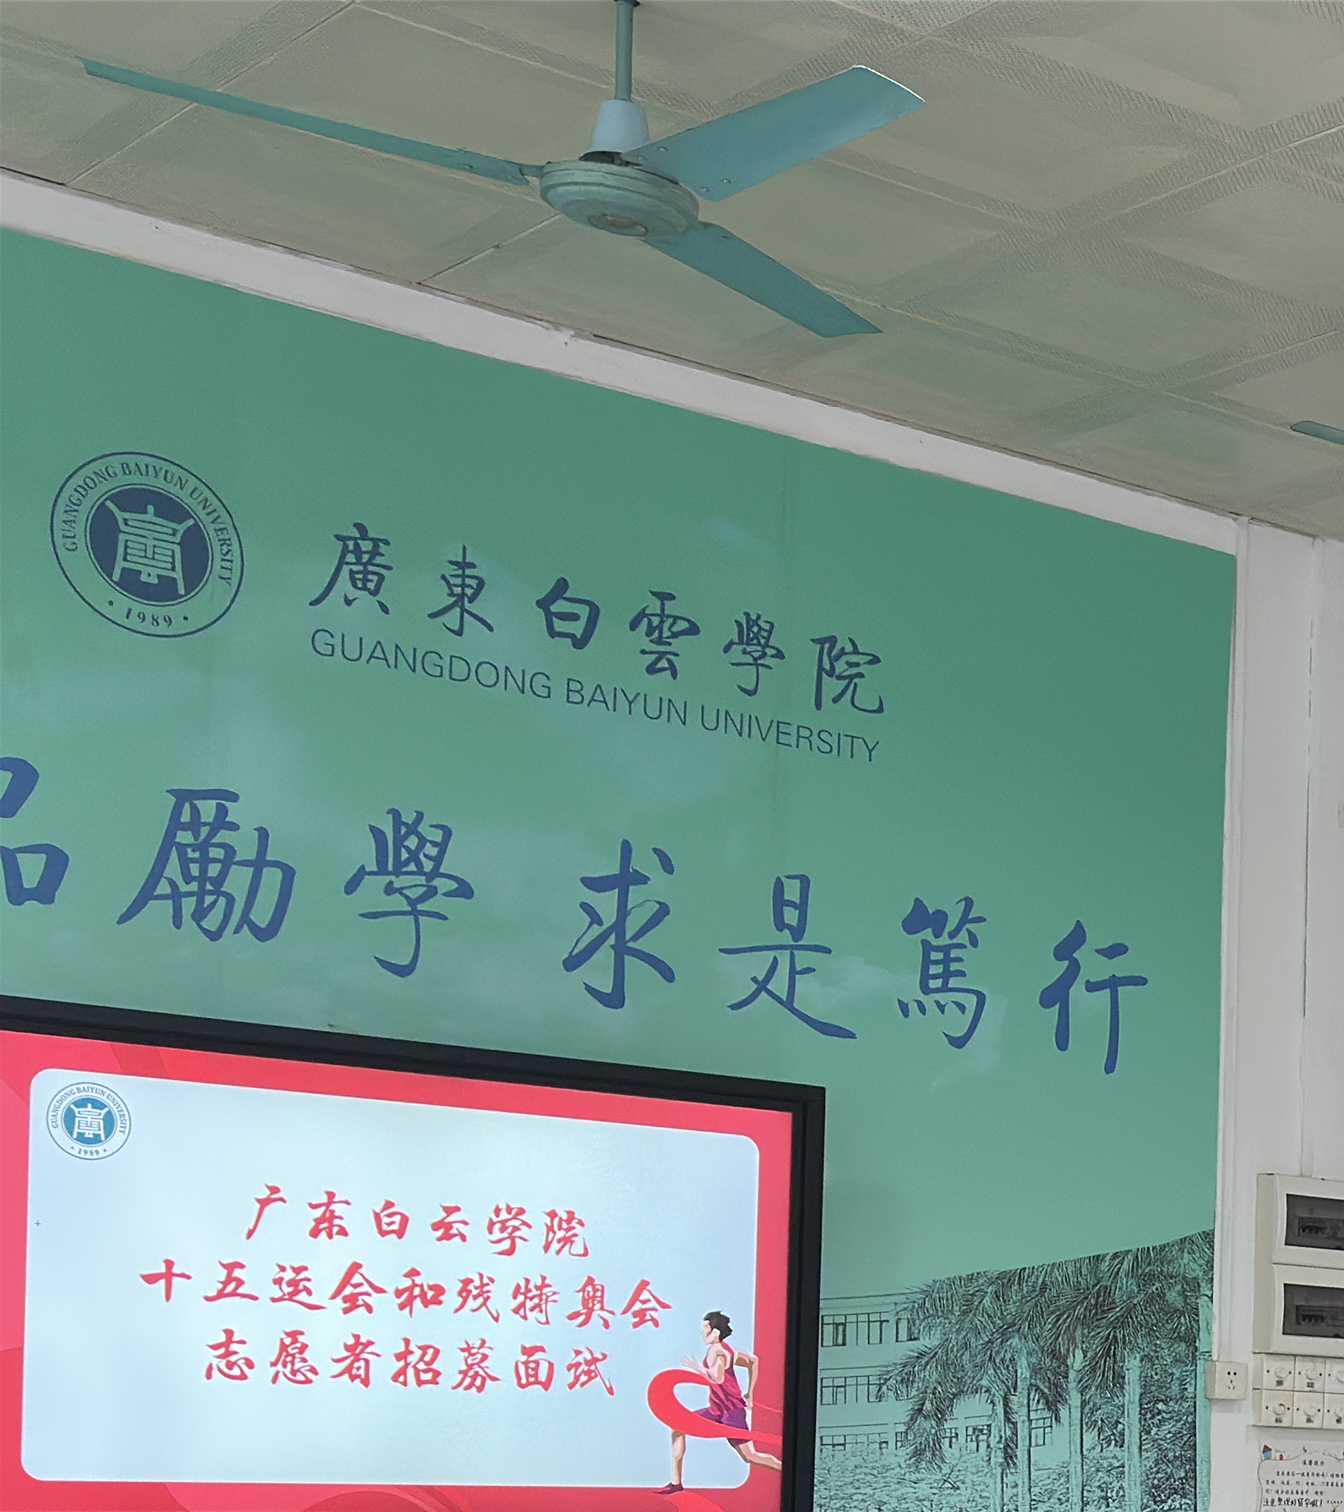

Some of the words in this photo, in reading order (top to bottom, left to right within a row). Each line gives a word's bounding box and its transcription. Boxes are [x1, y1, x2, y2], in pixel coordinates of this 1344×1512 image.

[62, 465, 119, 552] GUANGDONG
[121, 461, 190, 491] BAIYUN
[188, 486, 234, 587] UNIVERSITY
[125, 607, 173, 628] 1989
[308, 521, 885, 715] 廣東白雲學院
[310, 628, 553, 701] GUANGDONG
[565, 676, 688, 727] BAIYUN
[700, 705, 881, 763] UNIVERSITY
[76, 1086, 107, 1098] BAIYUN
[246, 1183, 590, 1257] 广东白云学院
[138, 1258, 674, 1330] 十五运会和残特奥会
[204, 1328, 615, 1397] 志愿者招募面试
